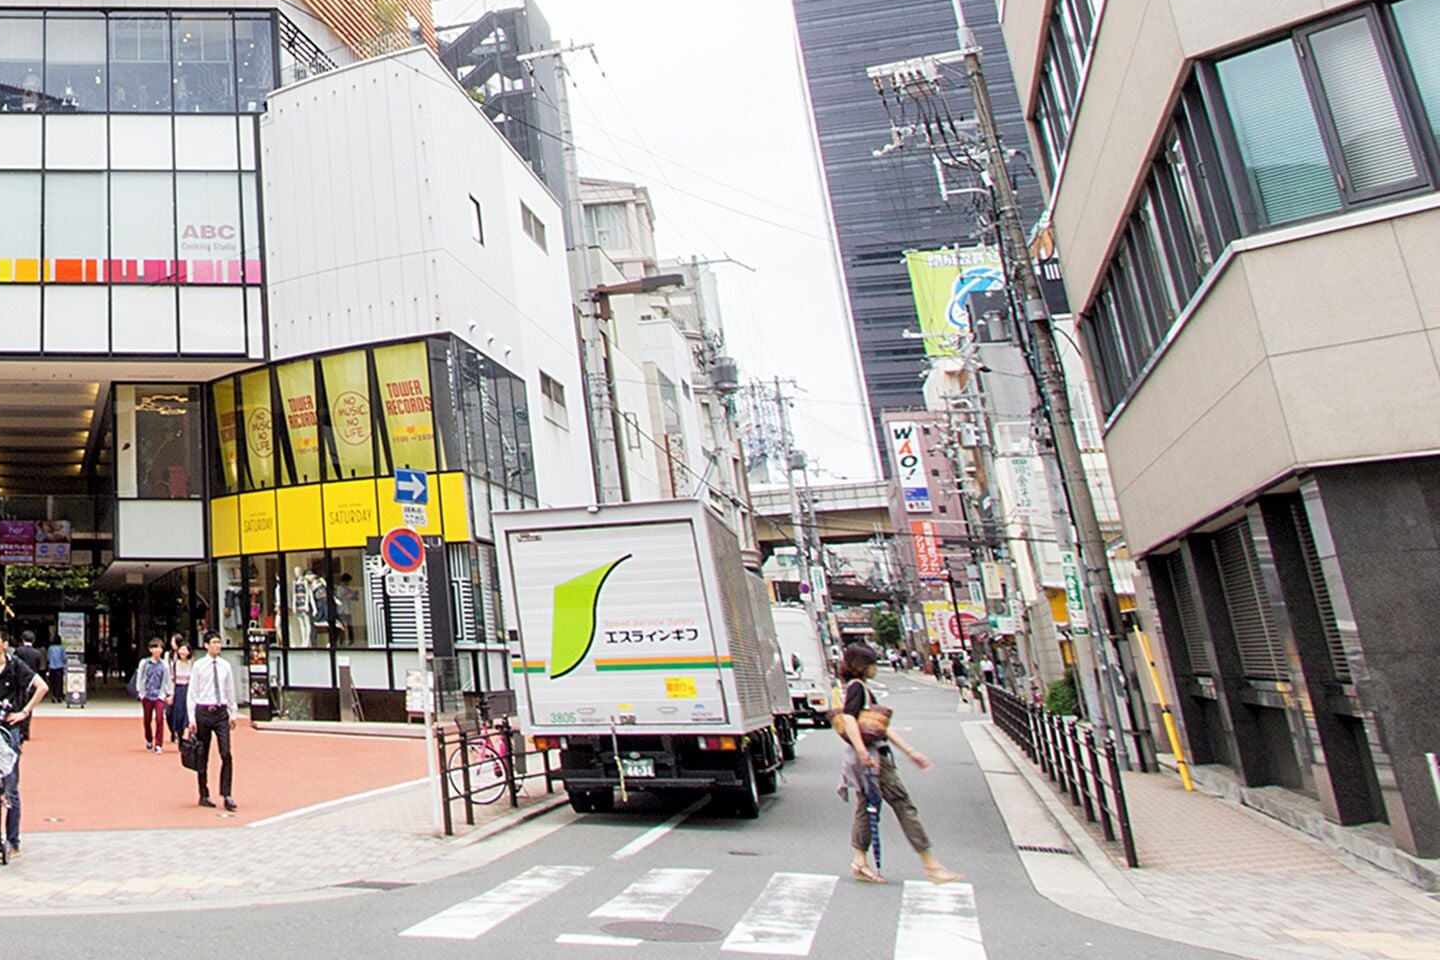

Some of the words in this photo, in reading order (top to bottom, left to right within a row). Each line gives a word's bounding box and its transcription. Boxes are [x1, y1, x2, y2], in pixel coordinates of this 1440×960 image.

[181, 224, 236, 240] ABC
[386, 379, 424, 399] TOWER
[287, 395, 313, 413] TOWER
[343, 396, 357, 406] NO
[385, 396, 432, 416] RECORDS
[346, 417, 360, 427] NO
[329, 508, 373, 526] SATURDAY
[243, 517, 273, 534] SATURDAY
[388, 583, 426, 595] ここから
[550, 712, 577, 723] 3805
